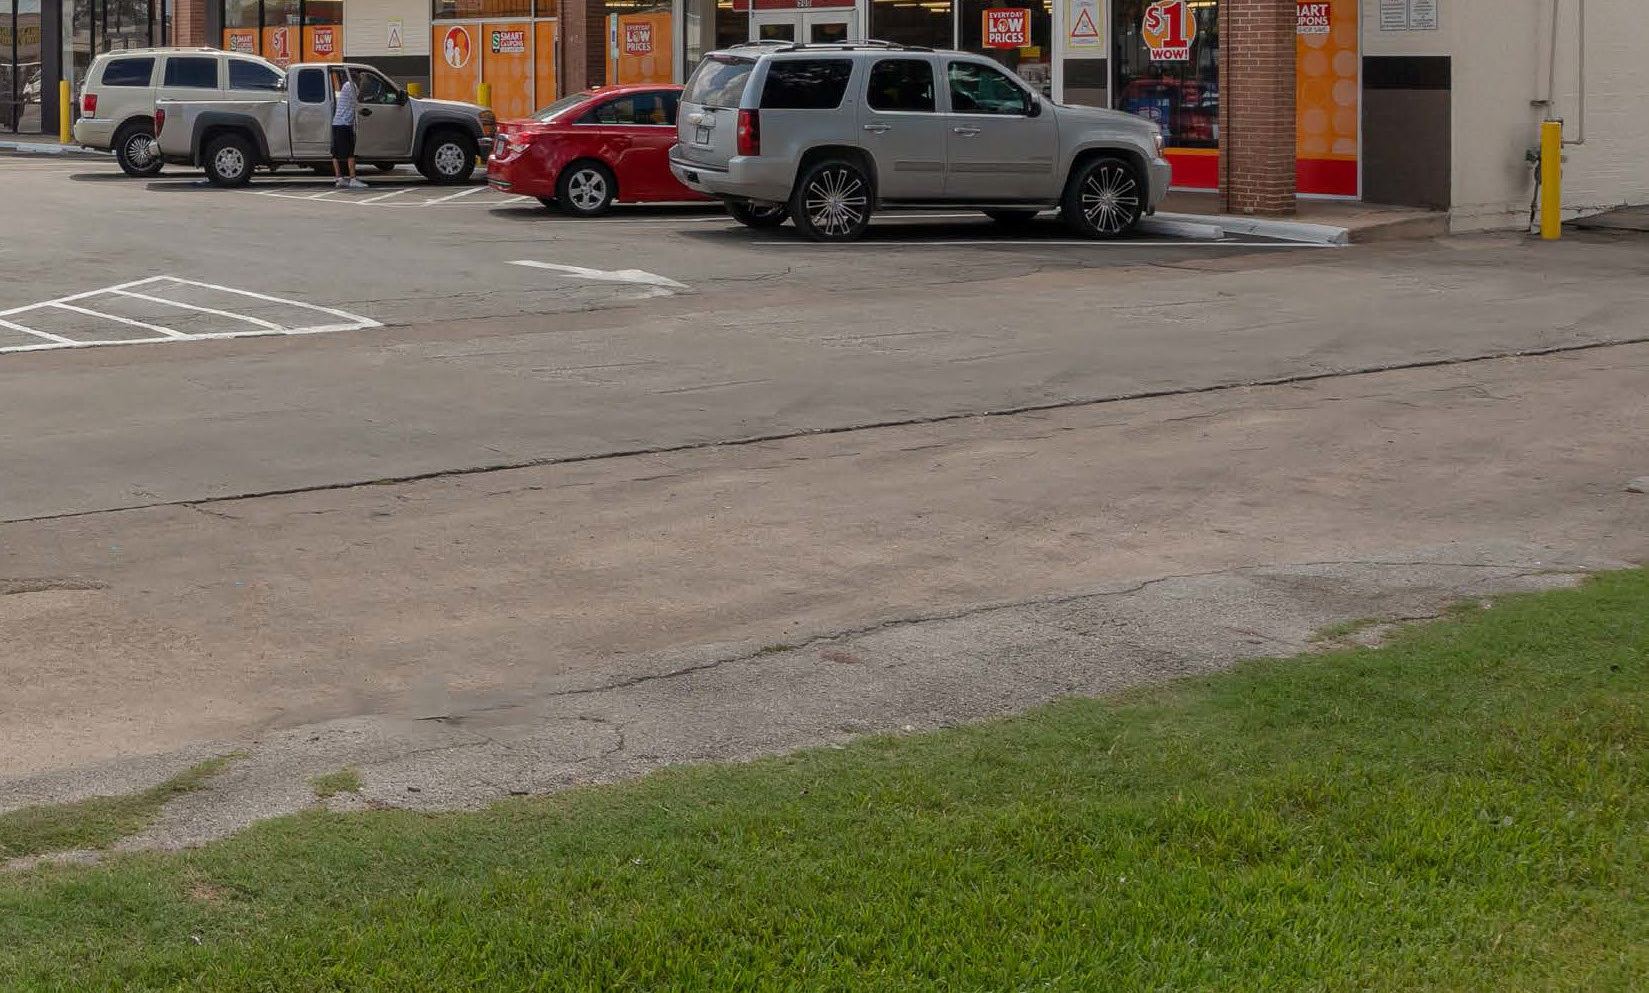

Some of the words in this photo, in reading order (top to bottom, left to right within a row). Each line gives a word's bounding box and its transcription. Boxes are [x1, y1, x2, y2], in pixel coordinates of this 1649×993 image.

[1297, 4, 1329, 16] ART
[989, 18, 1024, 32] LOW
[1147, 1, 1188, 48] $1
[315, 34, 332, 44] LOW
[500, 31, 524, 42] SMART
[626, 31, 651, 42] LOW
[989, 32, 1024, 44] PRICES
[315, 44, 333, 52] PRICES
[626, 42, 651, 52] PRICES
[1152, 49, 1188, 60] WOW!
